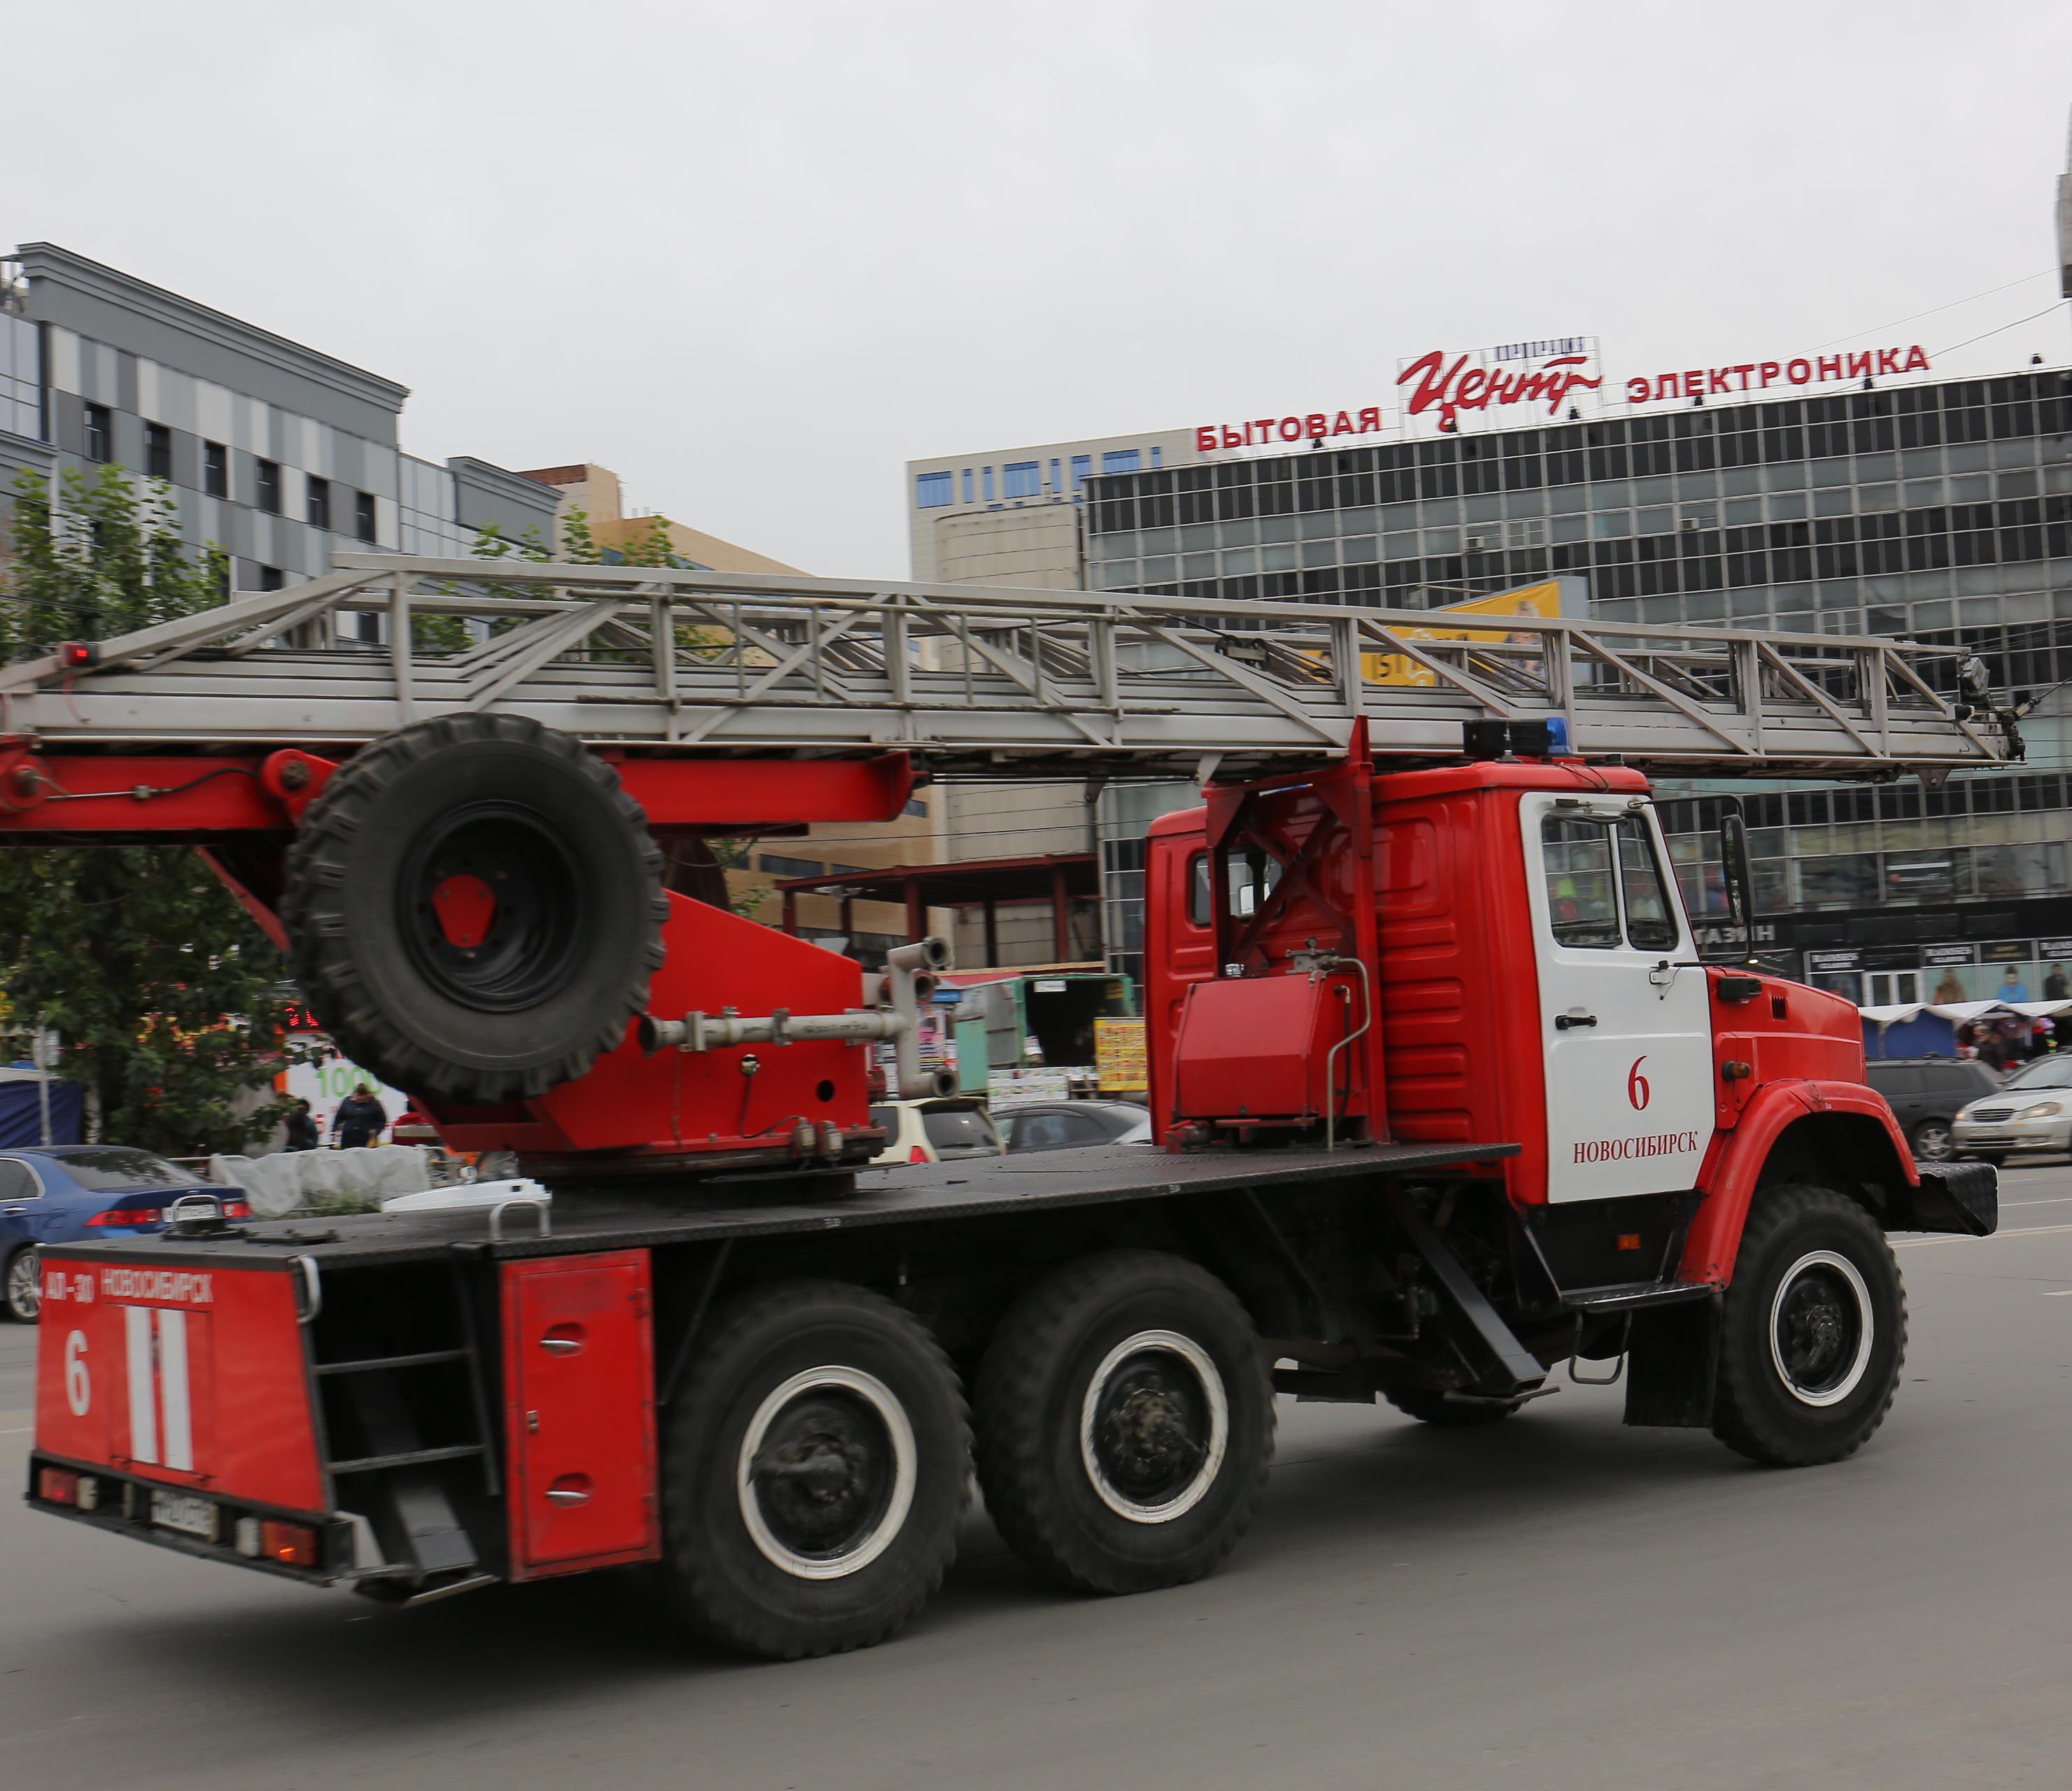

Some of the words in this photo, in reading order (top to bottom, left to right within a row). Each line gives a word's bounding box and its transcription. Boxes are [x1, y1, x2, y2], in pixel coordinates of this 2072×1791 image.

[1396, 351, 1602, 432] Центр
[1628, 344, 1930, 404] ЭЛЕКТРОНИКА
[1197, 406, 1381, 451] БЫТОВАЯ
[1628, 1055, 1650, 1111] 6
[1573, 1131, 1698, 1164] НОВОСИБИРСК
[100, 1268, 213, 1303] НОВОСИБИРСК
[64, 1329, 90, 1417] 6
